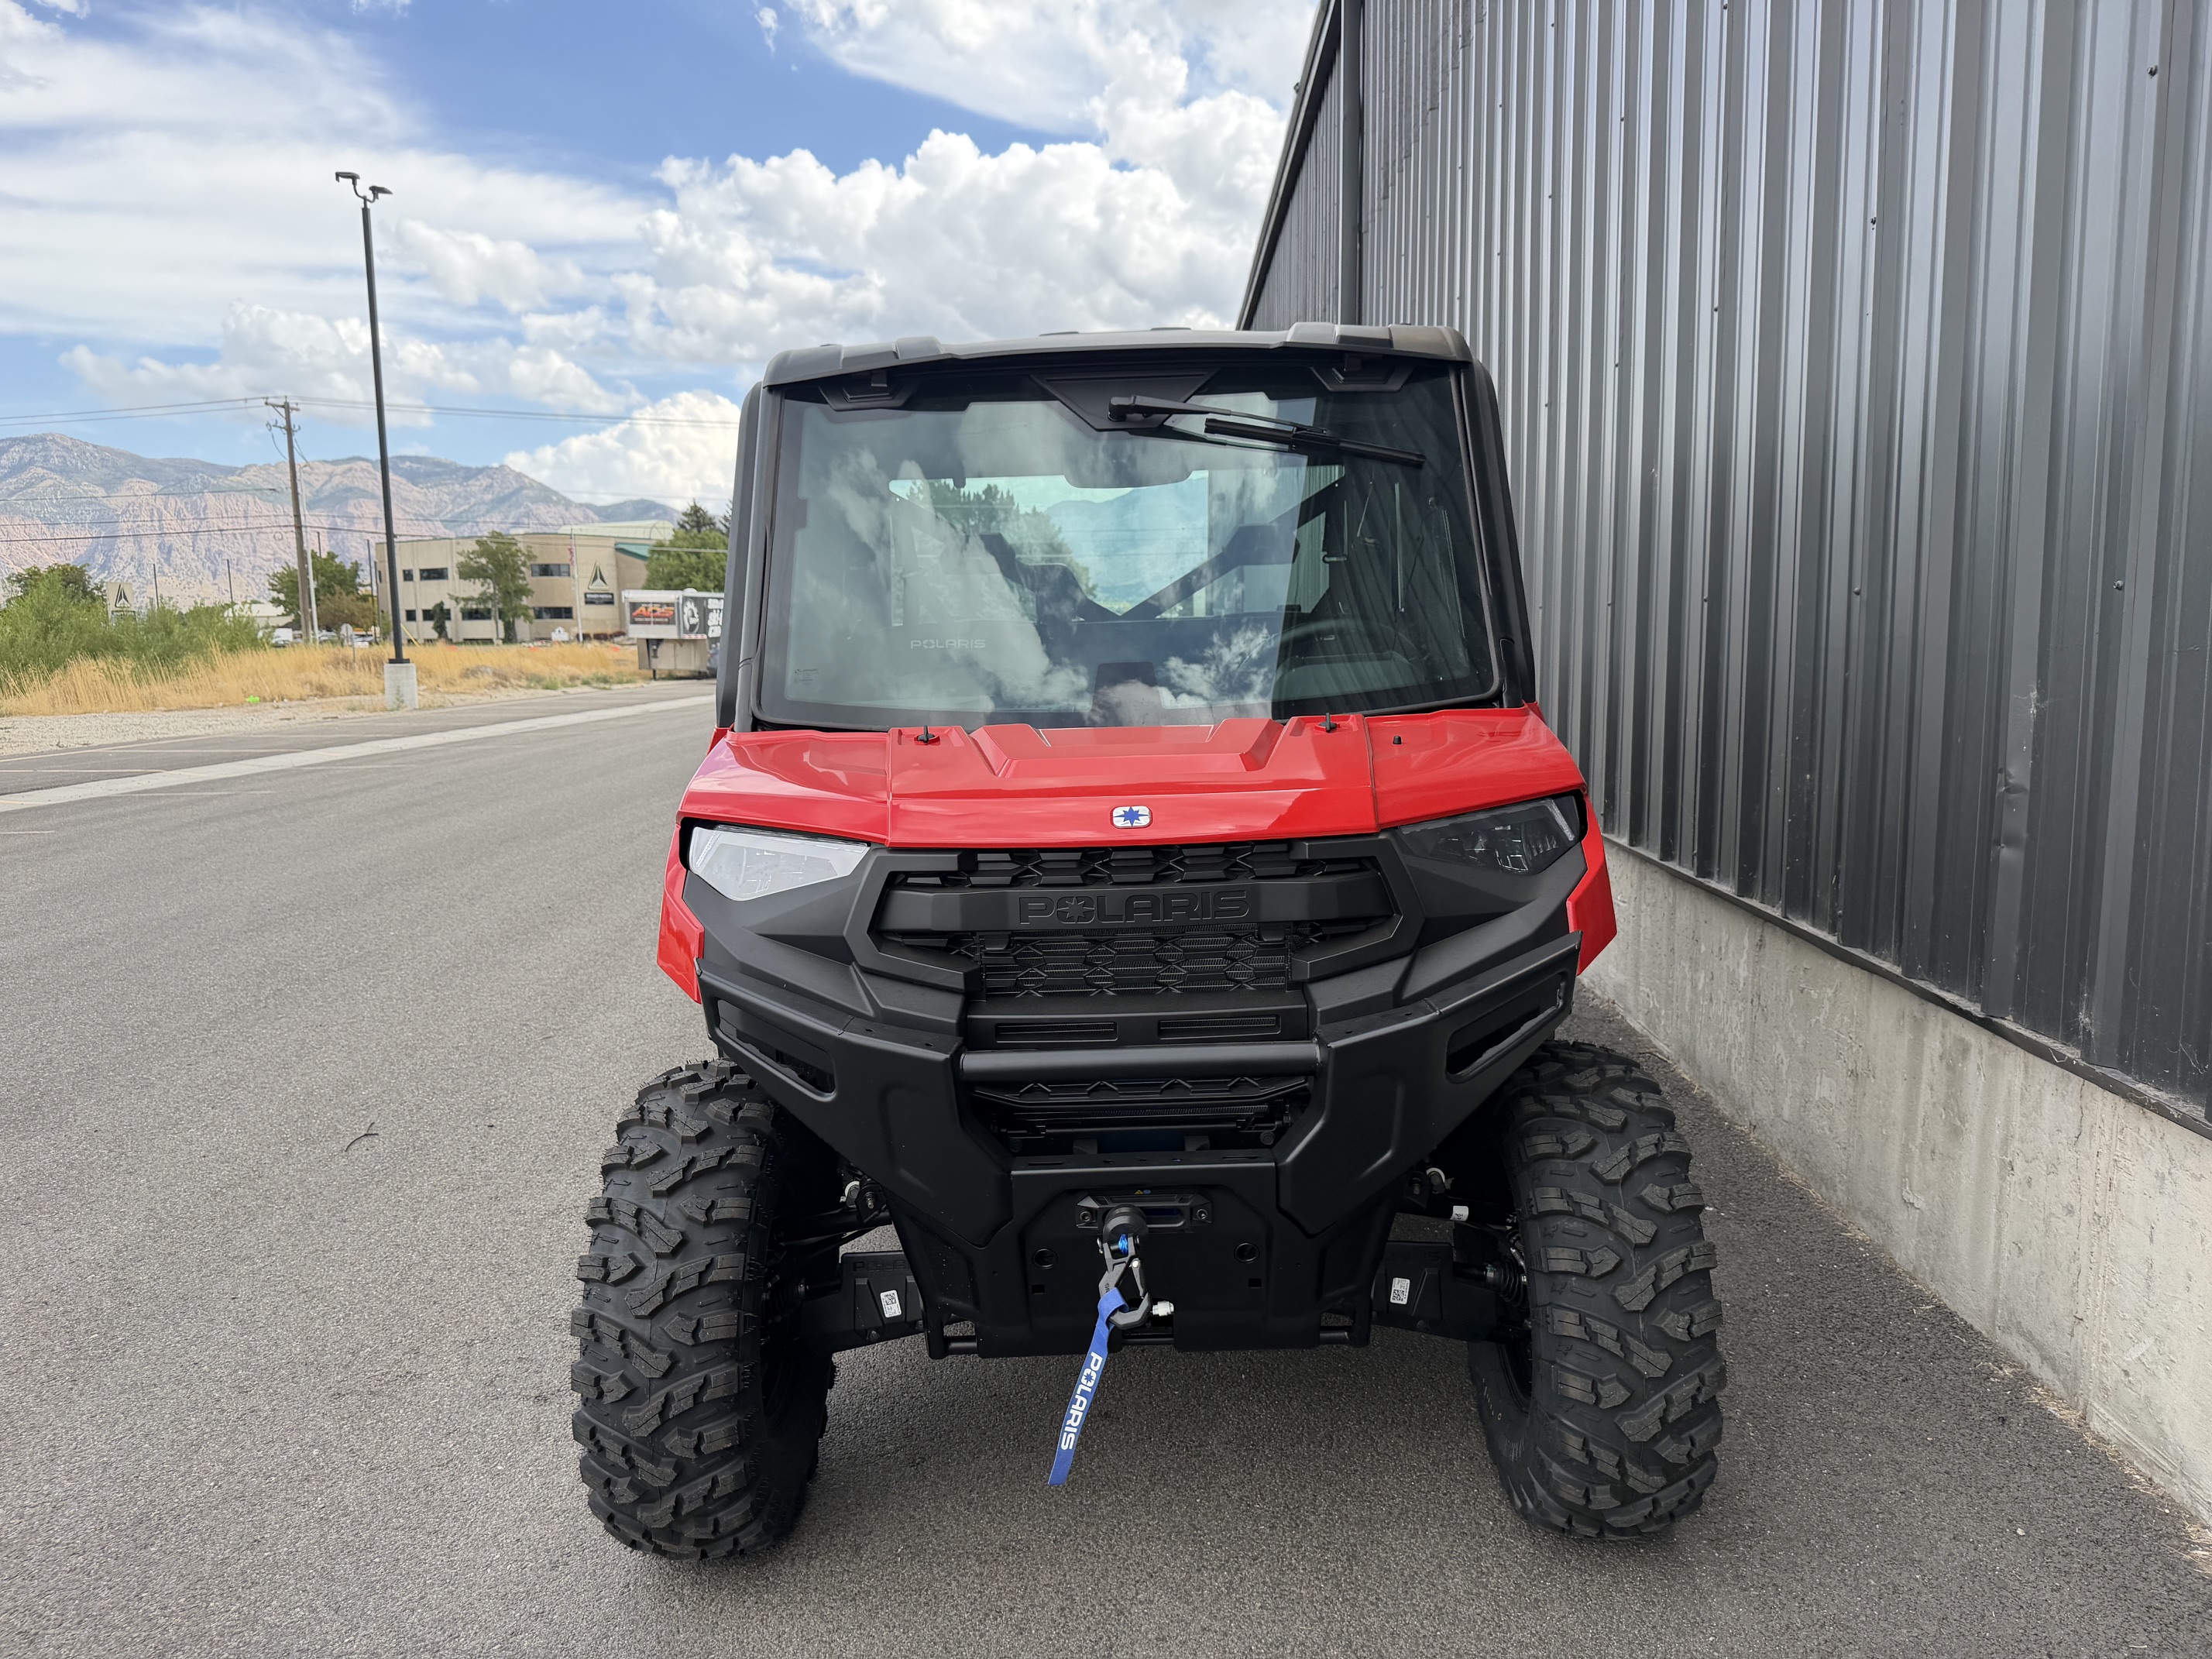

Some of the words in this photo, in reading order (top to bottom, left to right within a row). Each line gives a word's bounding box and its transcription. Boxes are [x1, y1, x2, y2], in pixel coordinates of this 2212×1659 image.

[910, 639, 986, 649] POLARIS
[1018, 891, 1249, 925] POLARIS
[1060, 1352, 1104, 1450] POLARIS
